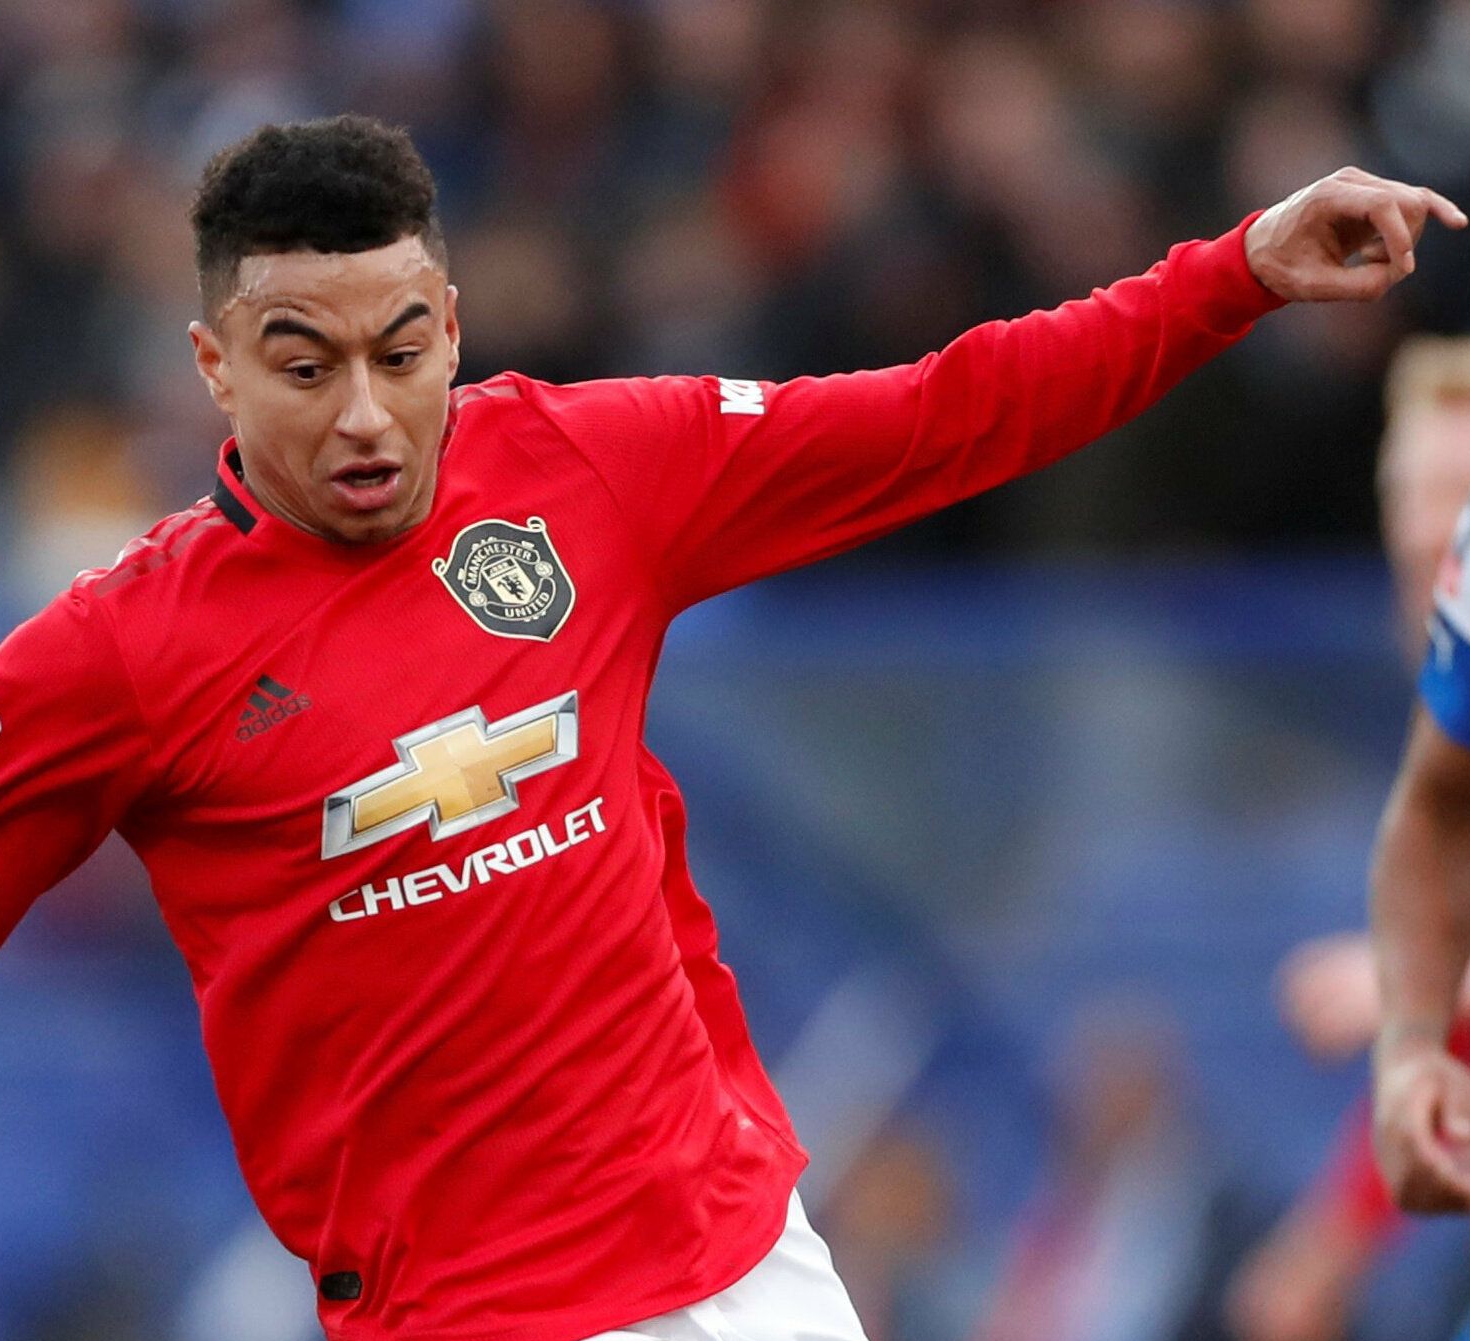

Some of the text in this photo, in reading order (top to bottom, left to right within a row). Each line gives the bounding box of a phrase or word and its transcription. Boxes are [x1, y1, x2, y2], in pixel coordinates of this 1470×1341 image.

[467, 543, 532, 585] MANCHESTER
[504, 592, 550, 618] UNITED
[236, 694, 312, 742] adidas
[329, 797, 607, 923] CHEVROLET
